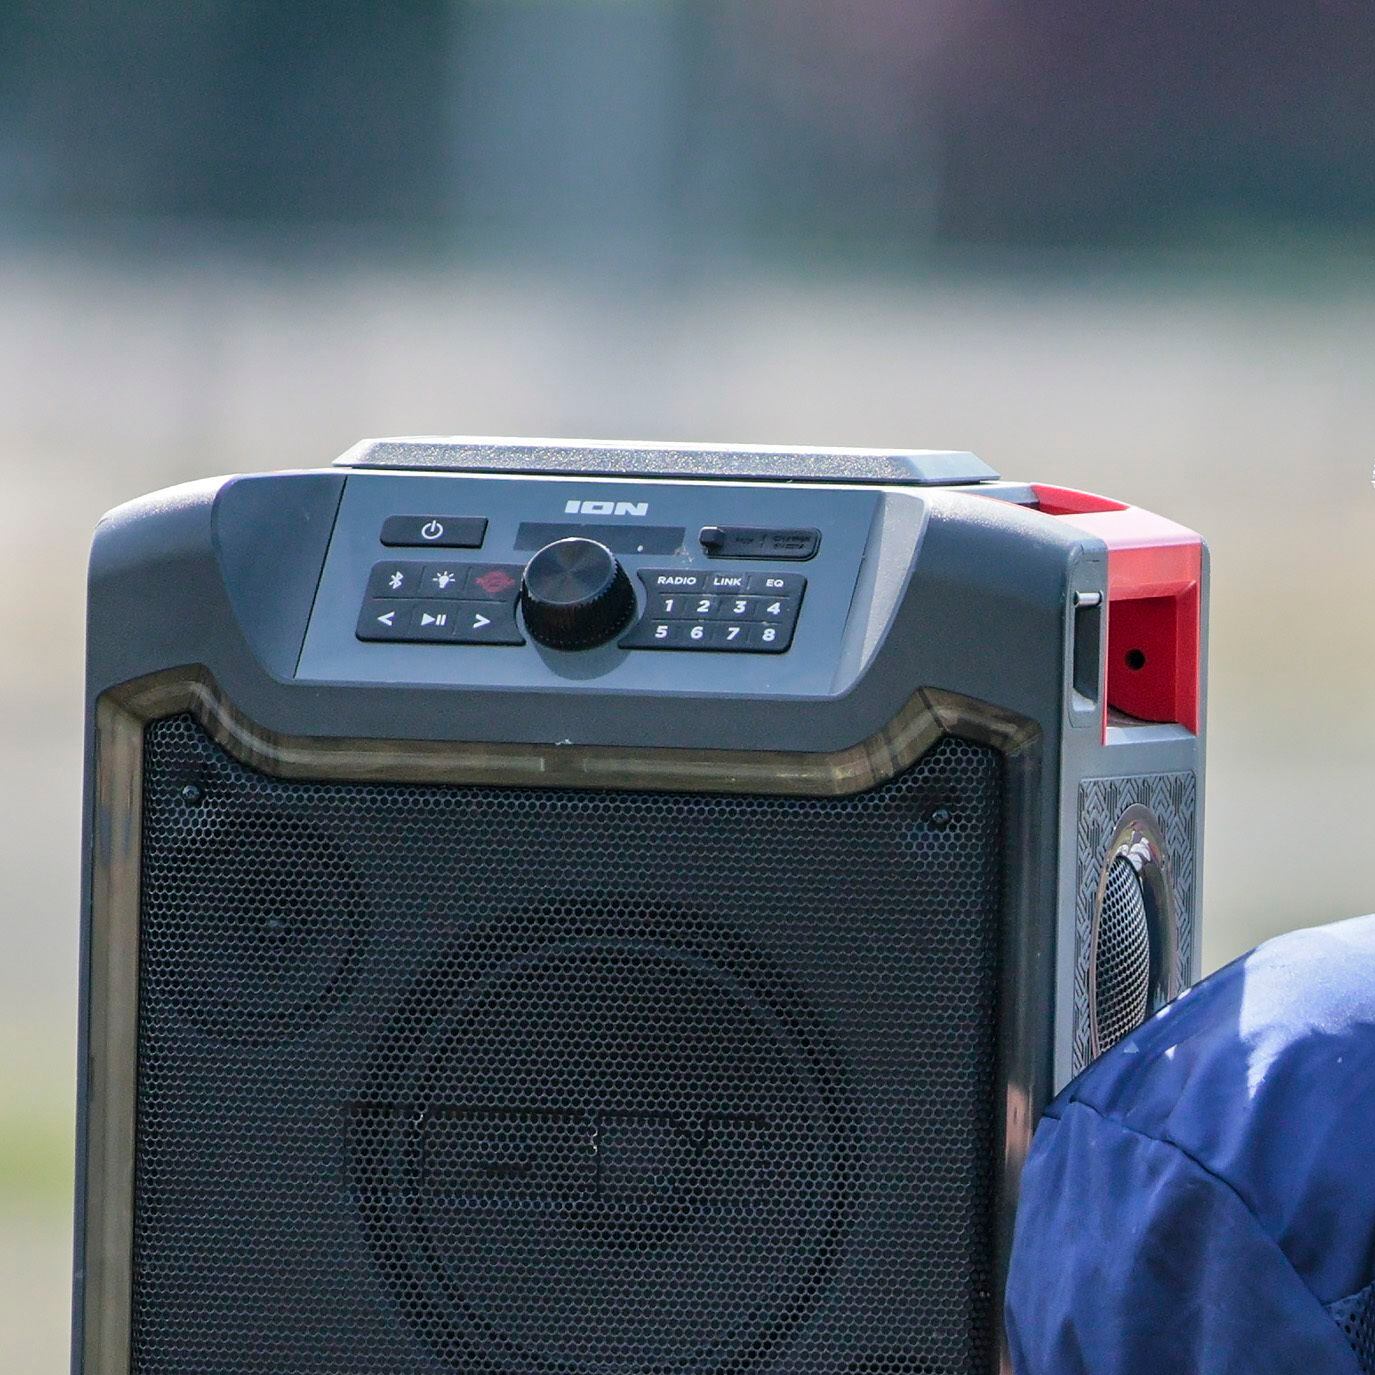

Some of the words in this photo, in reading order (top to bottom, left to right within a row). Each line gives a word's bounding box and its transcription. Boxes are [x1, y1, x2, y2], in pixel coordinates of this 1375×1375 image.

[564, 500, 649, 517] ION
[657, 576, 697, 585] RADIO
[713, 577, 742, 586] LINK
[765, 578, 784, 588] EQ
[665, 599, 674, 612] 1
[696, 600, 710, 613] 2
[733, 601, 747, 614] 3
[766, 602, 781, 615] 4
[655, 625, 668, 639] 5
[690, 626, 703, 639] 6
[726, 627, 740, 640] 7
[762, 628, 776, 642] 8
